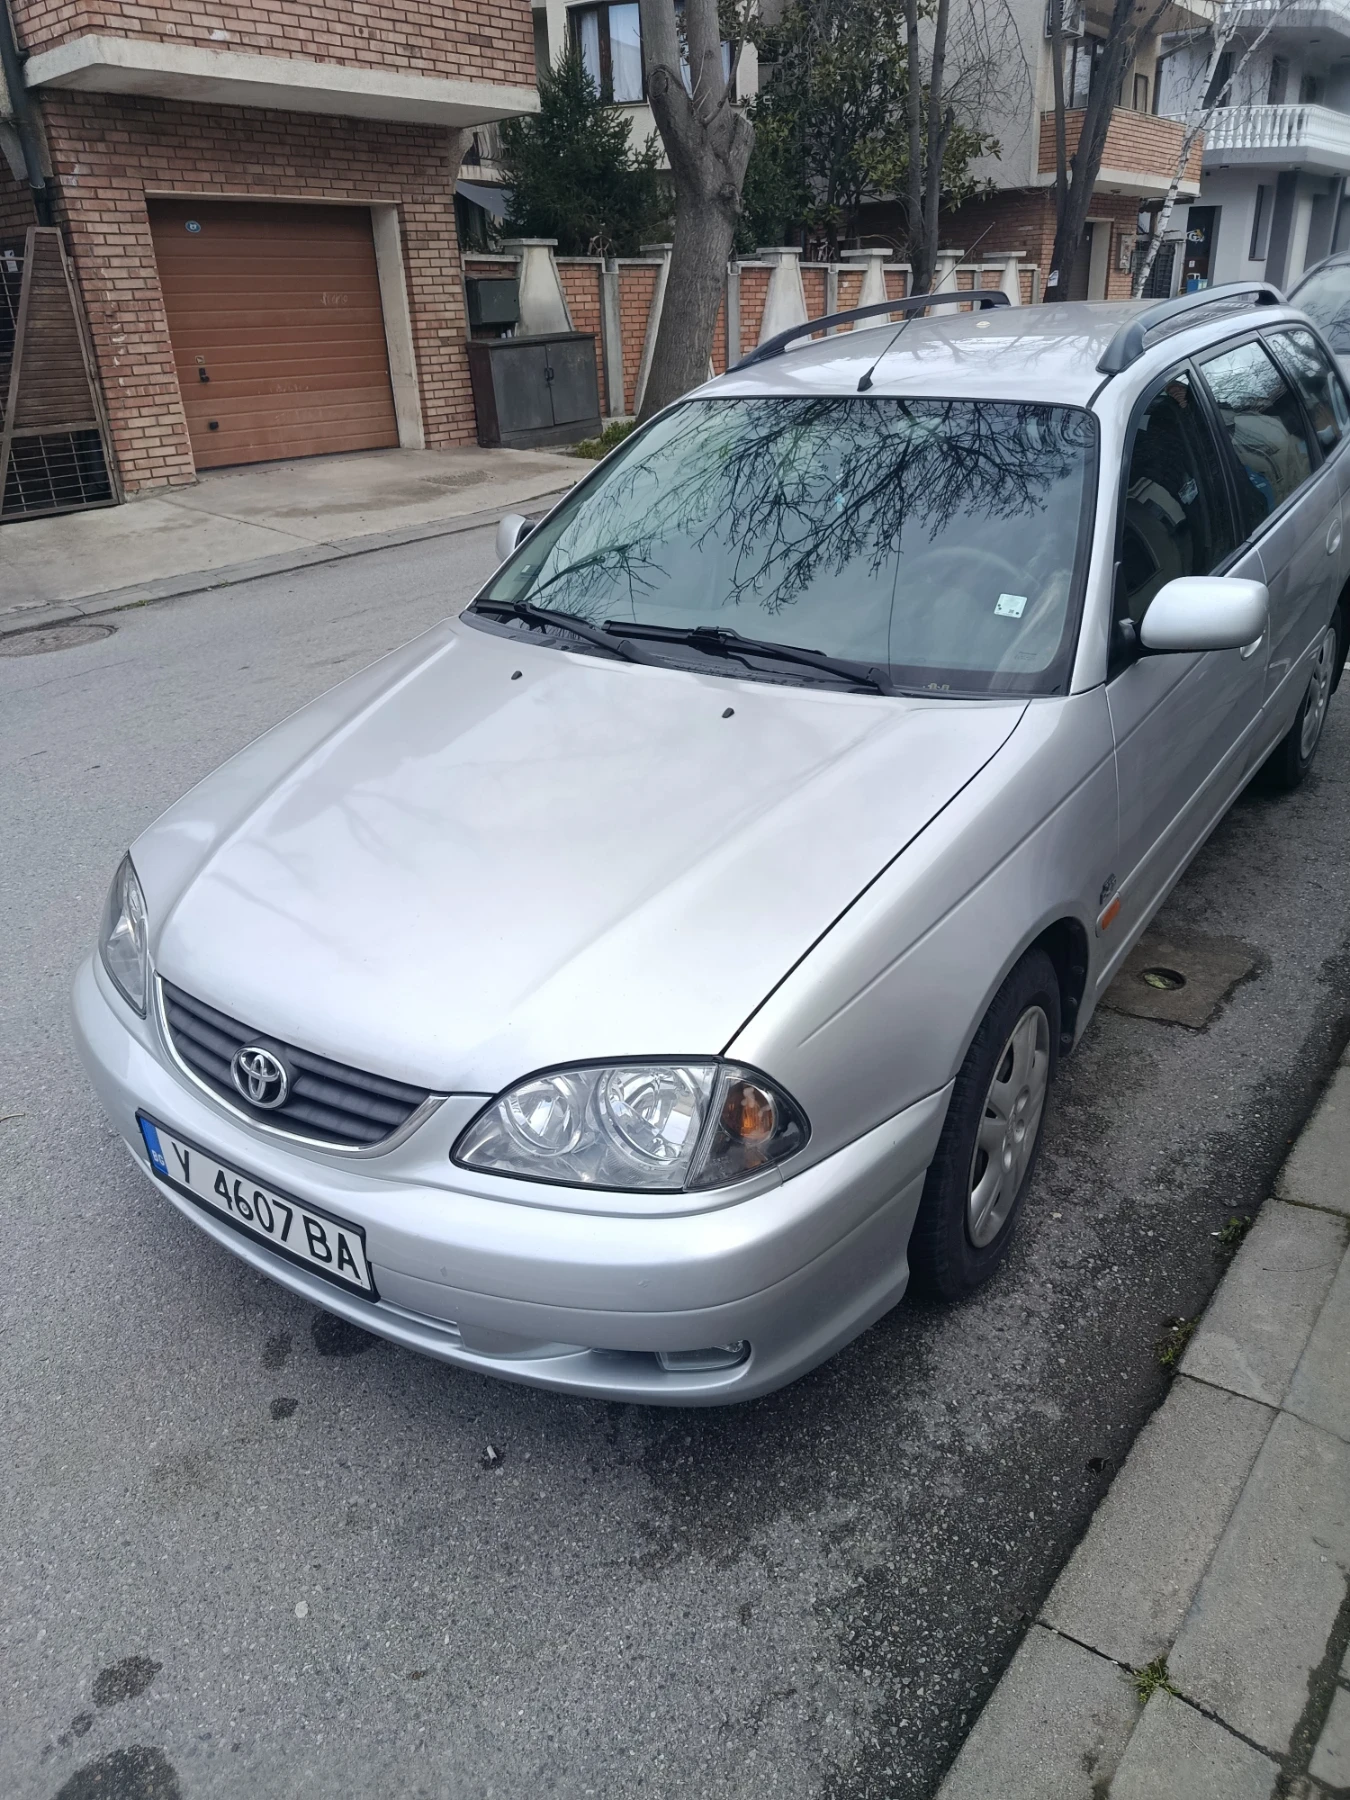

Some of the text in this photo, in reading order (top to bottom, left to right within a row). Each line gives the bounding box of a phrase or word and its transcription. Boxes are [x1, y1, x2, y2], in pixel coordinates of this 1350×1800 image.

[151, 1149, 165, 1166] BG
[172, 1141, 362, 1281] Y 4607 BA
